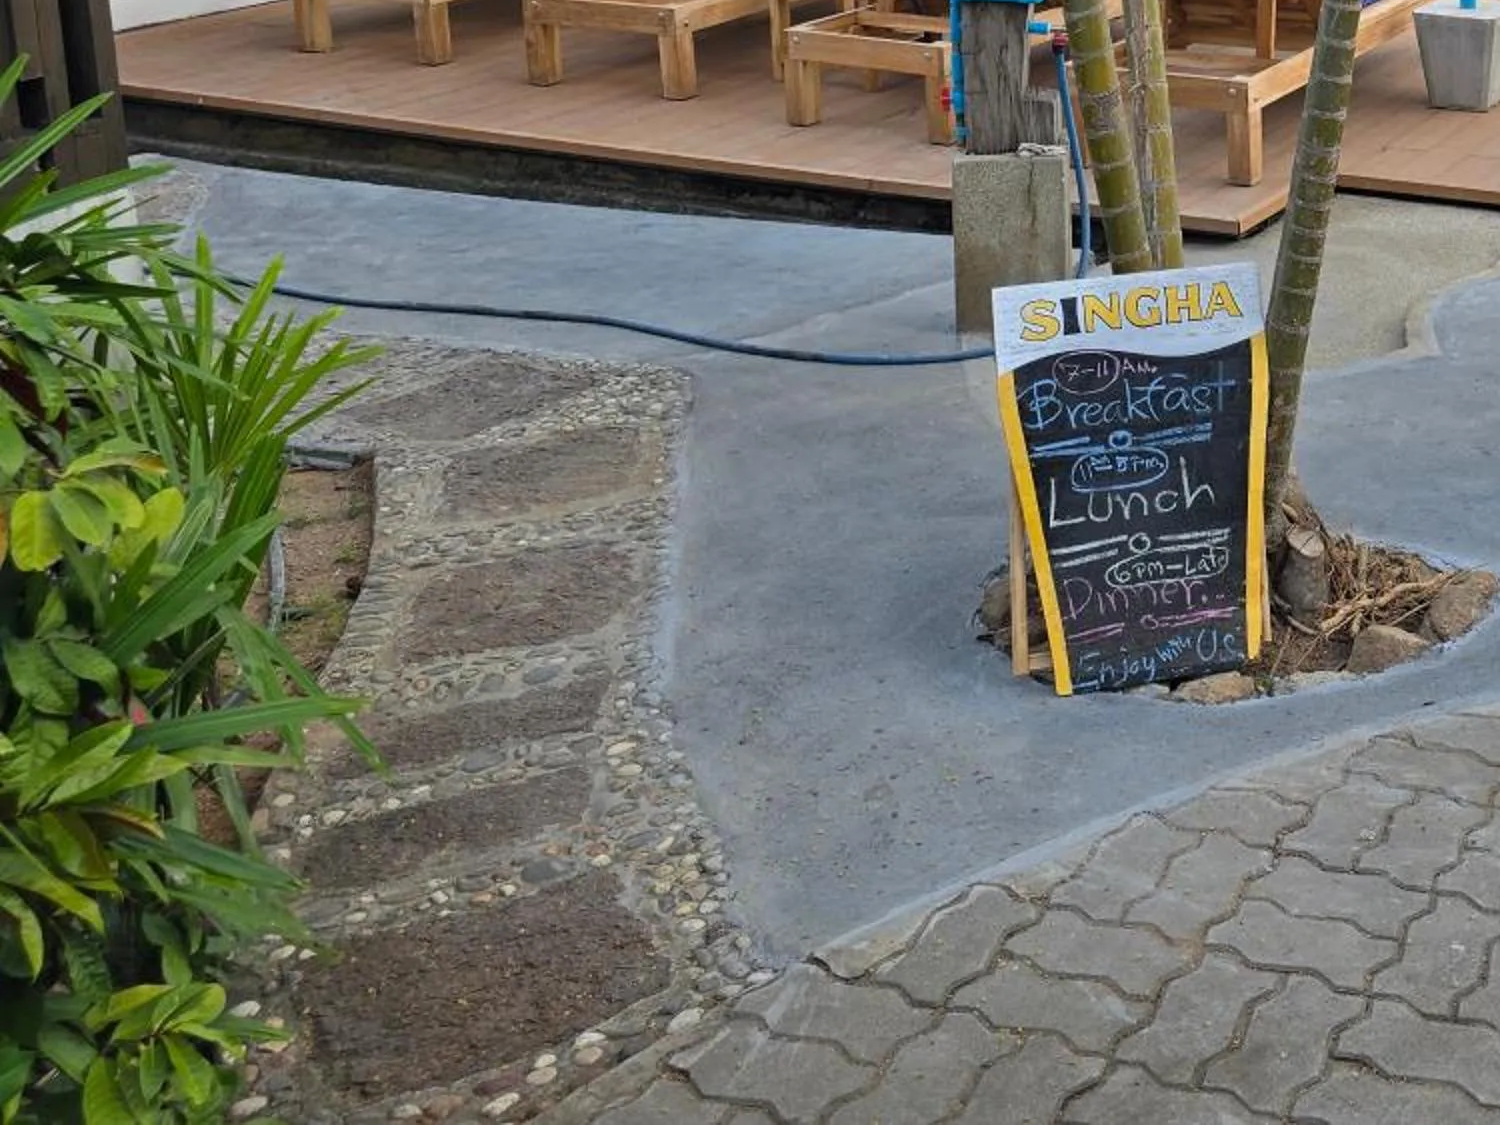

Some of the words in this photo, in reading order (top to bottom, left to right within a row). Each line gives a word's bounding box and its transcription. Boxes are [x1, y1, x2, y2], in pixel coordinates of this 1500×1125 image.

[1020, 282, 1243, 342] SINGHA
[1018, 361, 1236, 430] Breakfast
[1050, 457, 1215, 527] Lunch
[1073, 645, 1156, 690] Enjoy
